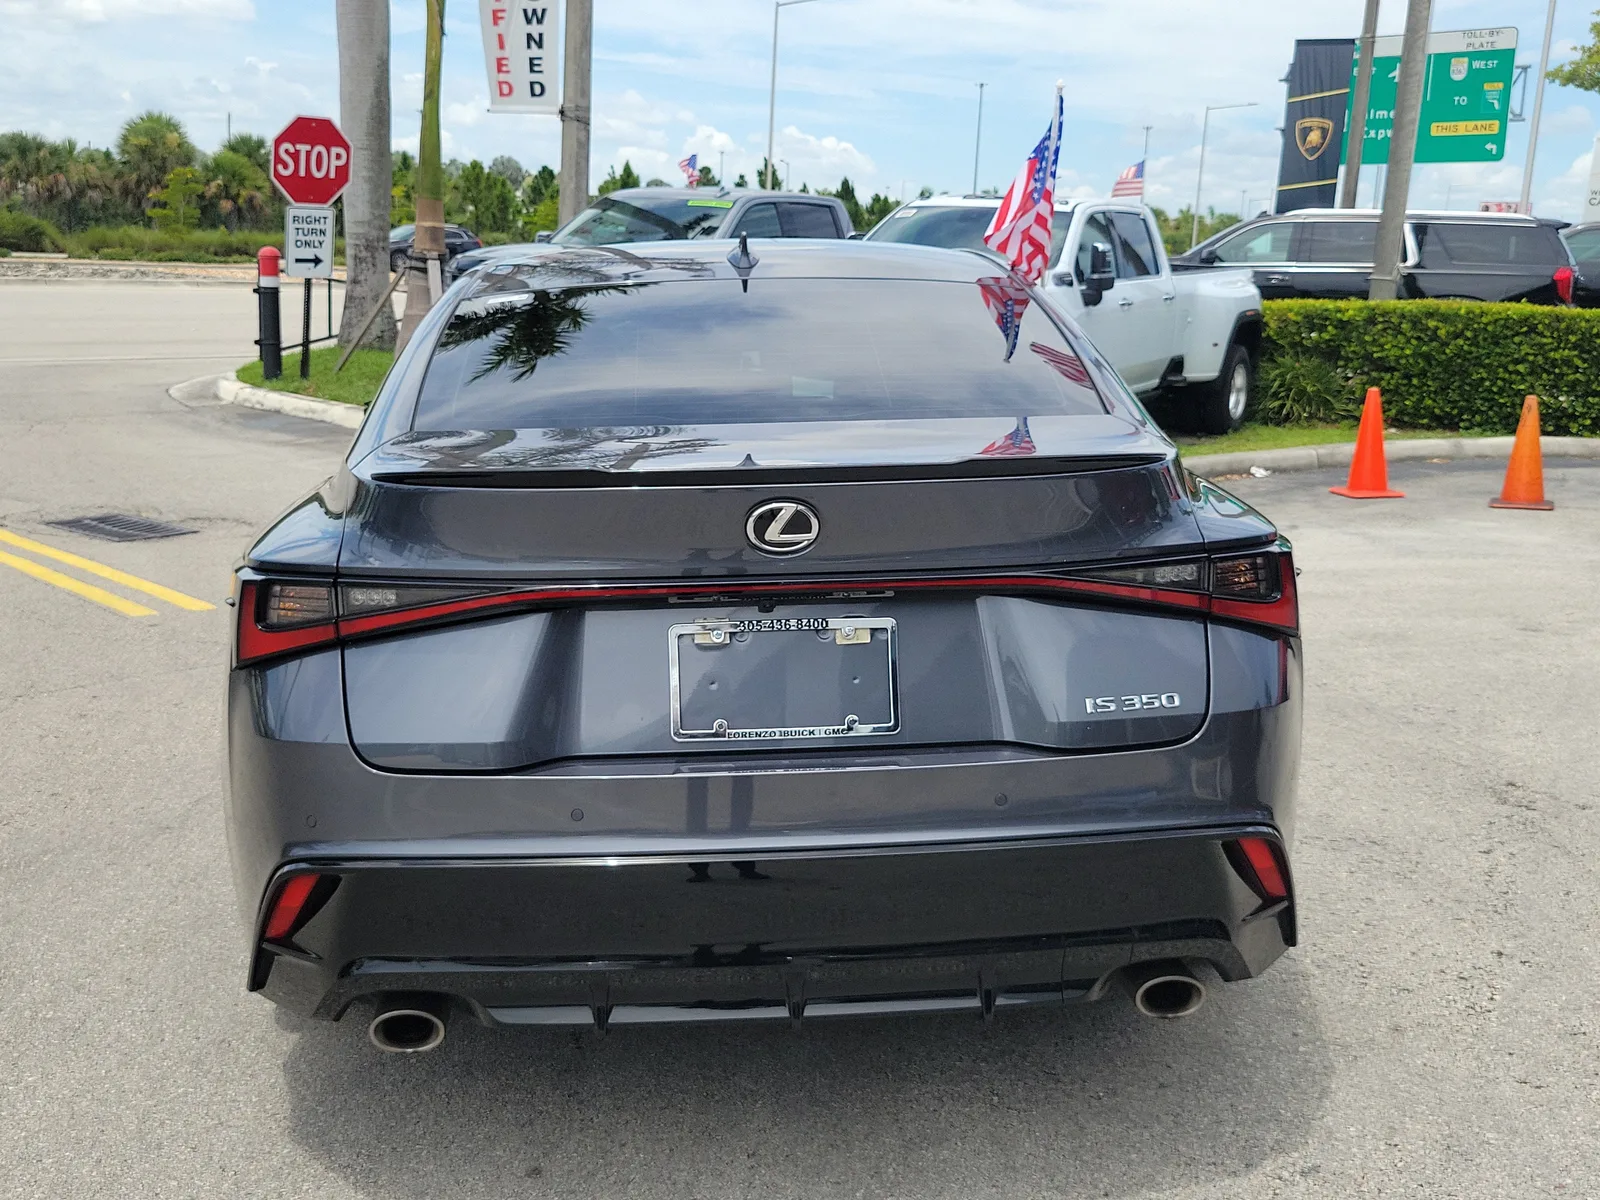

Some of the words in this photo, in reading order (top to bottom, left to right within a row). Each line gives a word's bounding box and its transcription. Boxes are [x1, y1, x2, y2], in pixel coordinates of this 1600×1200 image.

[492, 0, 514, 98] FIED
[522, 0, 548, 98] WNED
[1466, 41, 1497, 50] PLATE
[1471, 59, 1499, 70] WEST
[1453, 95, 1468, 106] TO
[1435, 124, 1459, 134] THIS
[1464, 122, 1496, 133] LANE
[276, 141, 348, 179] STOP
[292, 215, 329, 226] RIGHT
[295, 227, 327, 238] TURN
[294, 239, 325, 250] ONLY
[738, 618, 830, 632] 305-436-8400
[1085, 696, 1117, 714] IS
[1120, 692, 1181, 712] 350
[727, 730, 777, 740] LORENZO
[824, 727, 849, 736] GMC
